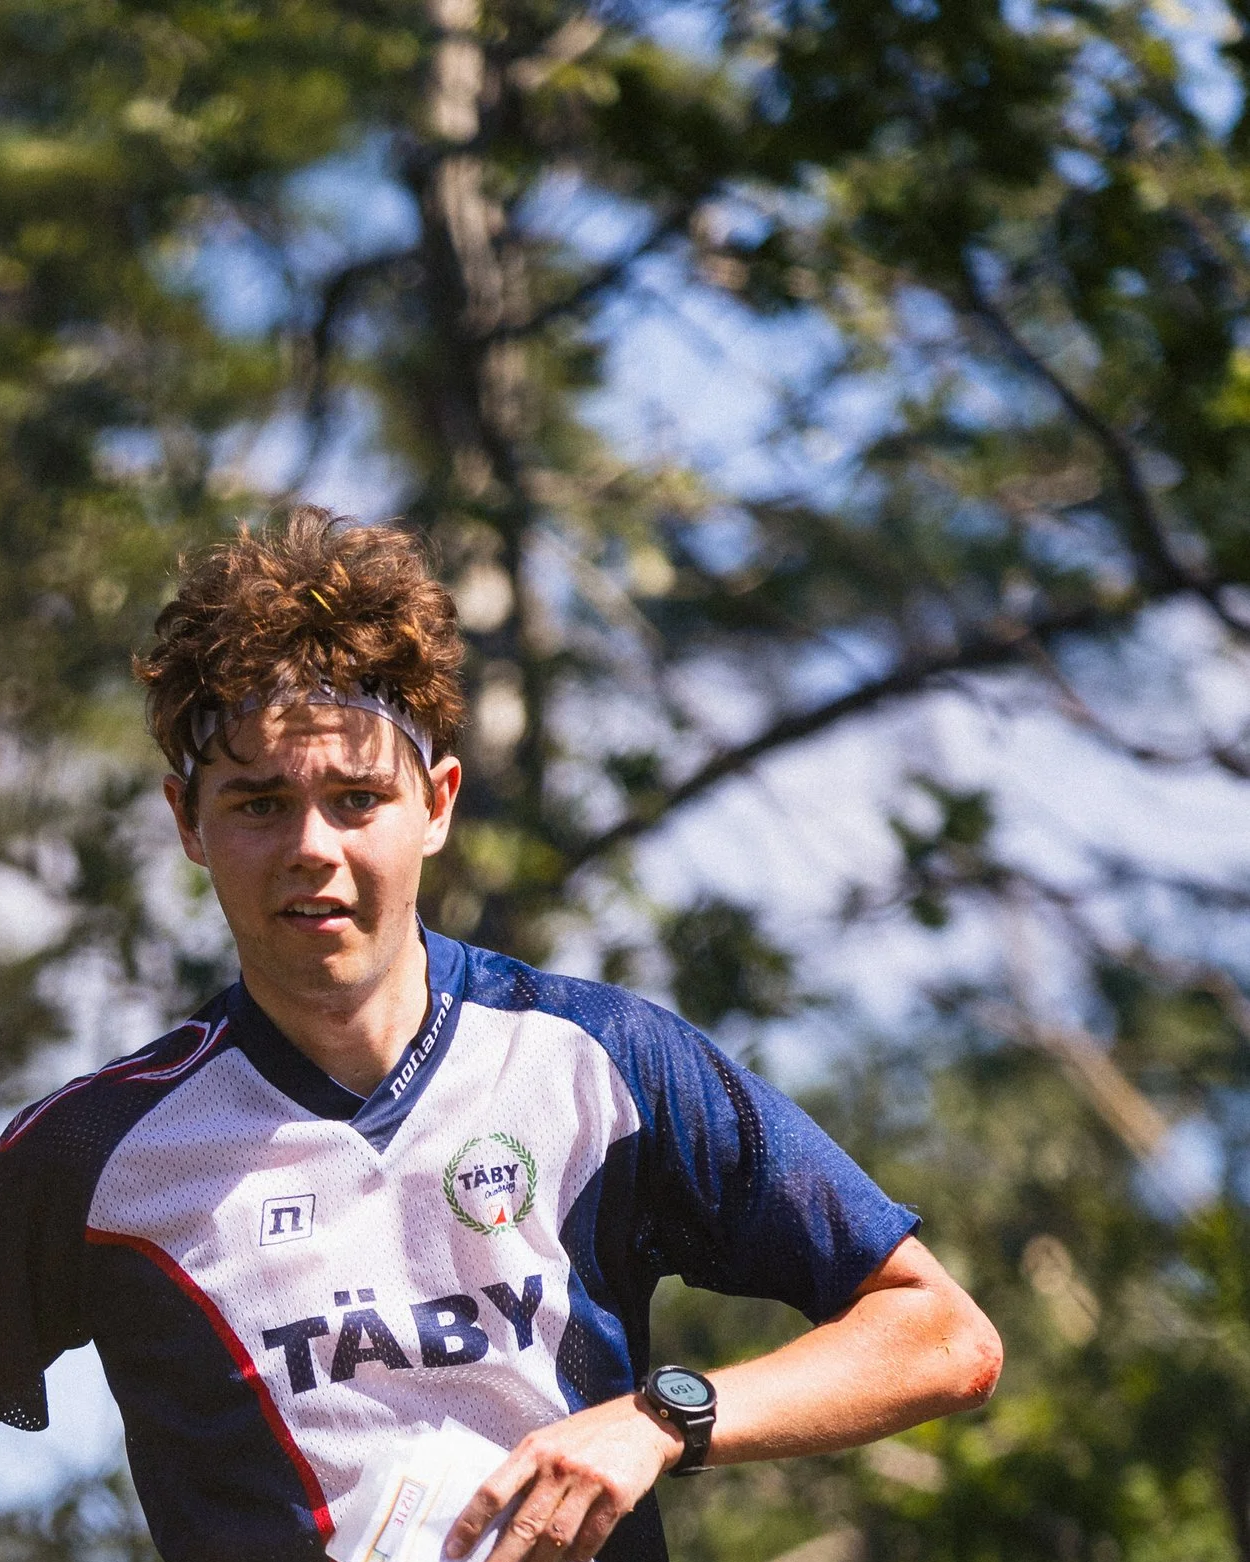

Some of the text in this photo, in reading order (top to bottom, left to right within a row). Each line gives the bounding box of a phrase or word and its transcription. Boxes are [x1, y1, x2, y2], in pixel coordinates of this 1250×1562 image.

[390, 992, 453, 1100] noname
[458, 1164, 519, 1191] TÄBY
[262, 1274, 543, 1395] TÄBY
